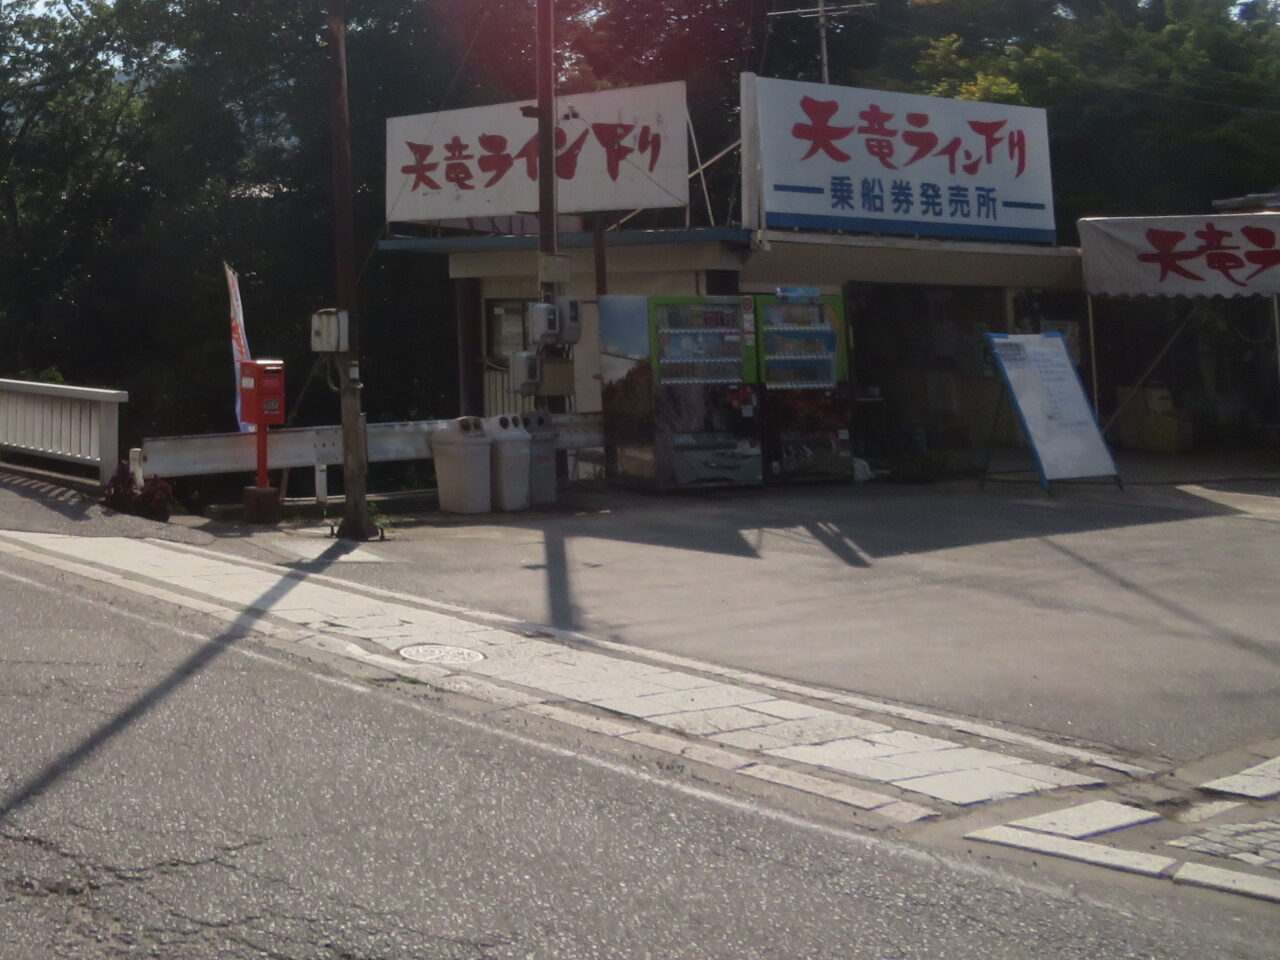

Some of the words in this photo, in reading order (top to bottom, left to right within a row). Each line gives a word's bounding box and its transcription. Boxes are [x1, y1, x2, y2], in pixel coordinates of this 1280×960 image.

[791, 95, 1027, 179] 天竜ライン下り
[830, 175, 998, 221] 乗船券発売所
